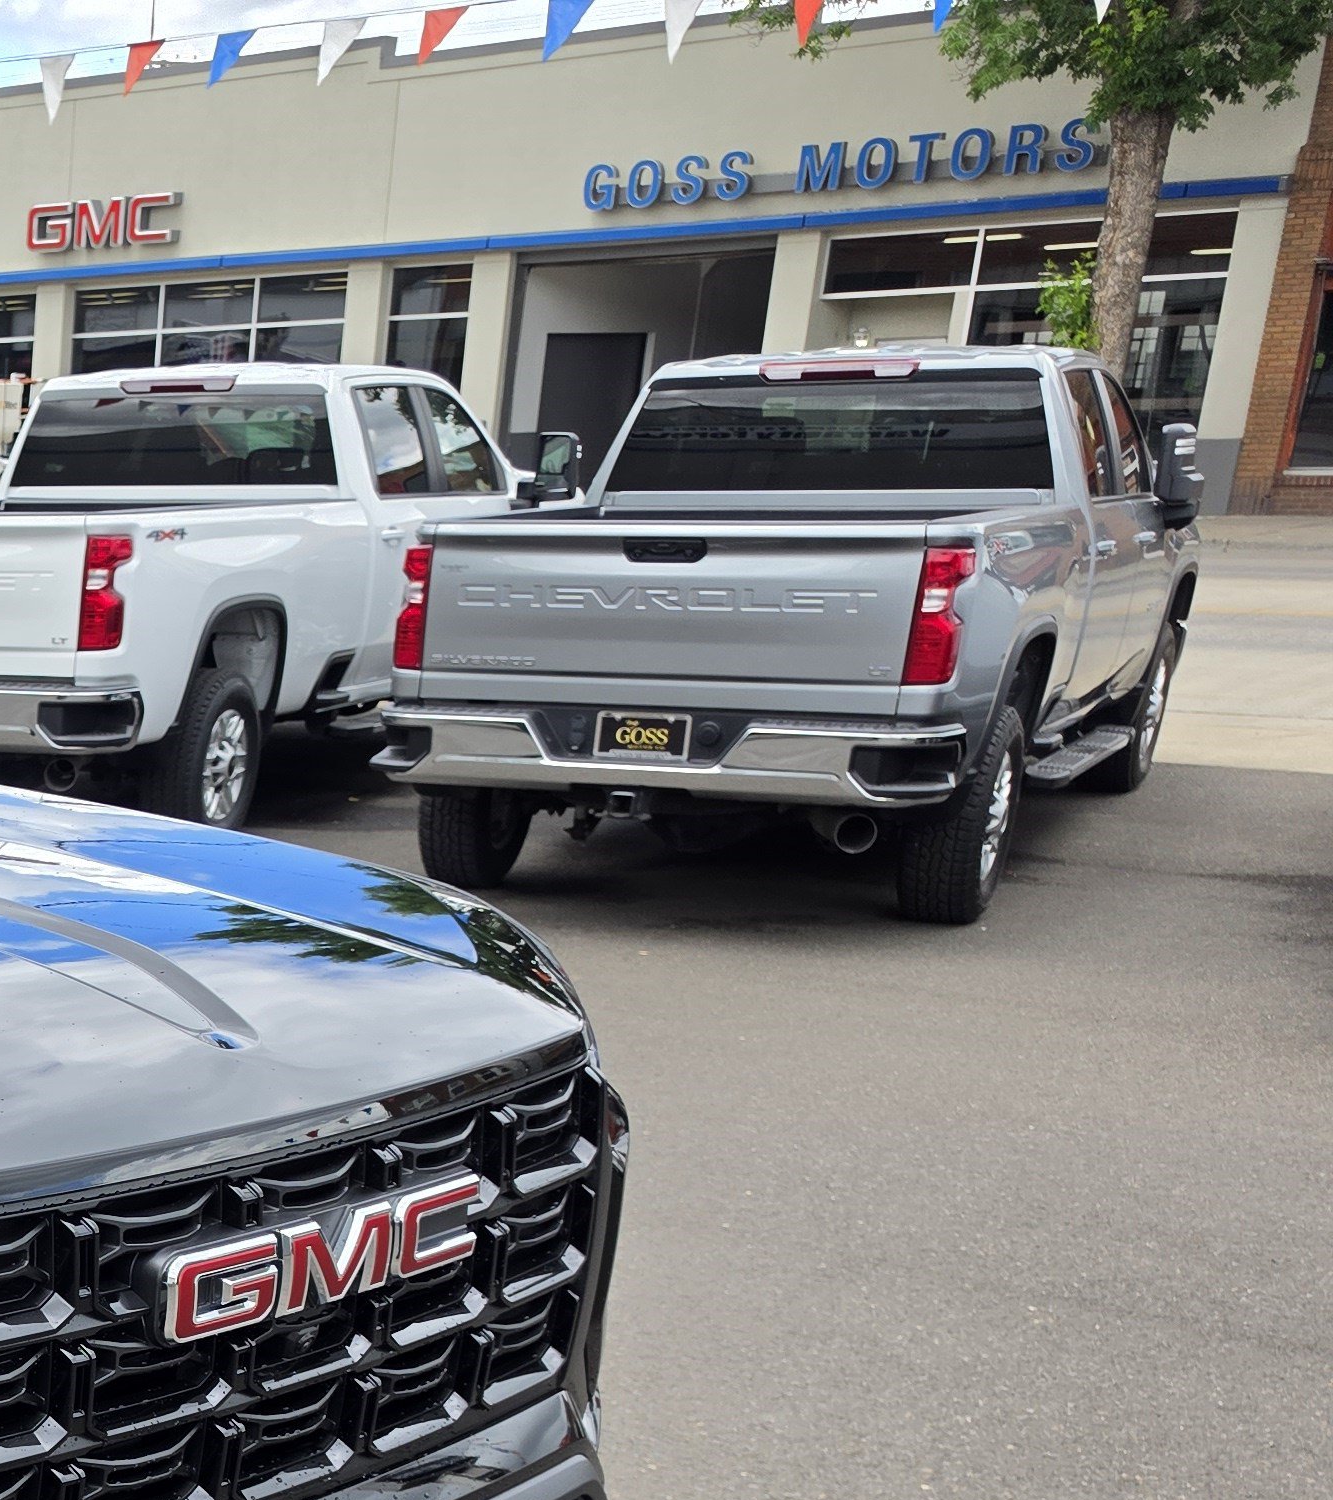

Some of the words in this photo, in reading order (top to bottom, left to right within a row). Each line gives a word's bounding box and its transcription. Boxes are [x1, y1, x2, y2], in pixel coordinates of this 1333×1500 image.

[583, 149, 754, 213] GOSS
[795, 117, 1099, 194] MOTORS
[26, 191, 183, 253] GMC
[457, 583, 878, 614] CHEVROLET
[51, 637, 69, 646] LT
[615, 726, 669, 746] GOSS
[164, 1173, 481, 1344] GMC
